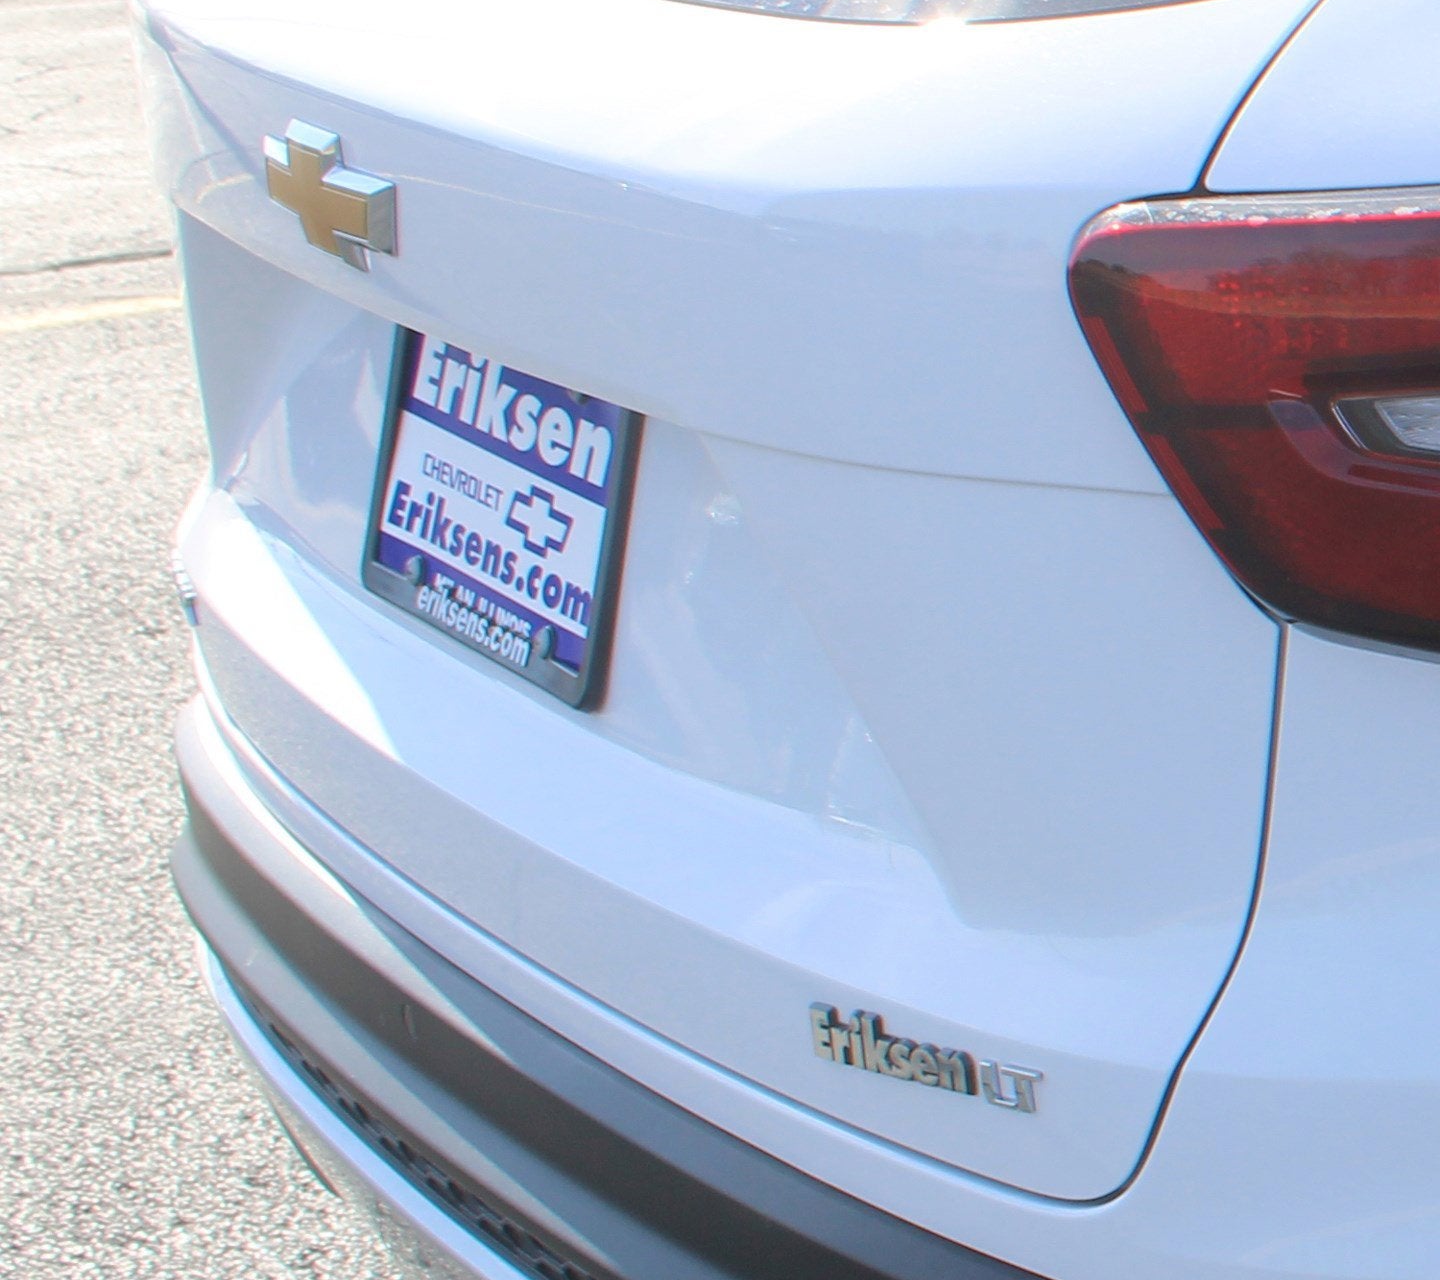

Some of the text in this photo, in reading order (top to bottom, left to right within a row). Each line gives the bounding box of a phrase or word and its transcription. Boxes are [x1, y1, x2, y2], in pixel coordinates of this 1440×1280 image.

[412, 335, 613, 489] Eriksen
[422, 452, 504, 512] CHEVROLET
[387, 479, 593, 625] Eriksens.com
[417, 584, 531, 668] eriksens.com
[809, 1001, 1043, 1114] Eriksen LT
